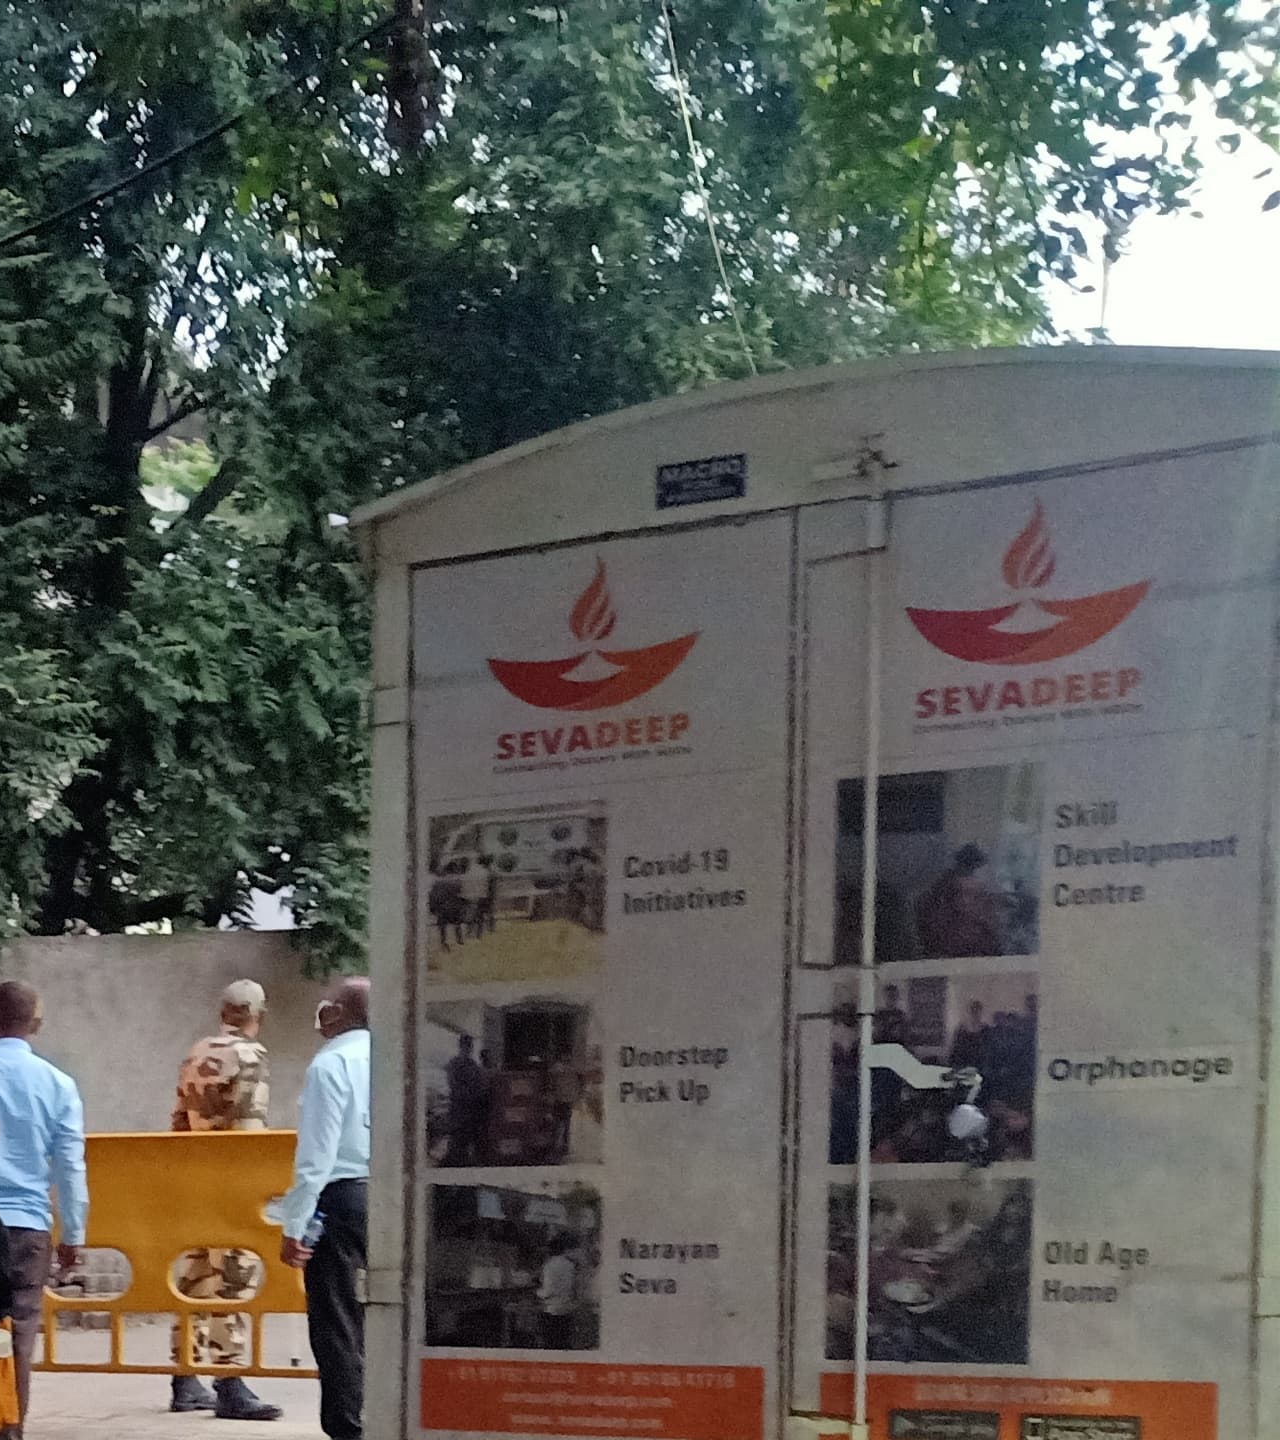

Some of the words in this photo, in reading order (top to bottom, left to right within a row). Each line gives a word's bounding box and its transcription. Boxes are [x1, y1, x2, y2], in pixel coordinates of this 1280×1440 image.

[914, 667, 1142, 719] SEVADEEP
[495, 712, 690, 760] SEVADEEP
[1055, 799, 1119, 829] Skill
[624, 848, 729, 879] Covid-19
[1053, 834, 1240, 868] Development
[623, 887, 747, 915] Initiatives
[1053, 882, 1146, 907] Centre
[619, 1046, 729, 1070] Doorstep
[1047, 1055, 1234, 1086] Orphanage
[619, 1080, 672, 1103] Pick
[678, 1079, 711, 1107] Up
[619, 1238, 720, 1264] Narayan
[1045, 1240, 1089, 1265] Old
[1094, 1240, 1150, 1271] Age
[619, 1272, 678, 1295] Seva
[1043, 1279, 1118, 1305] Home
